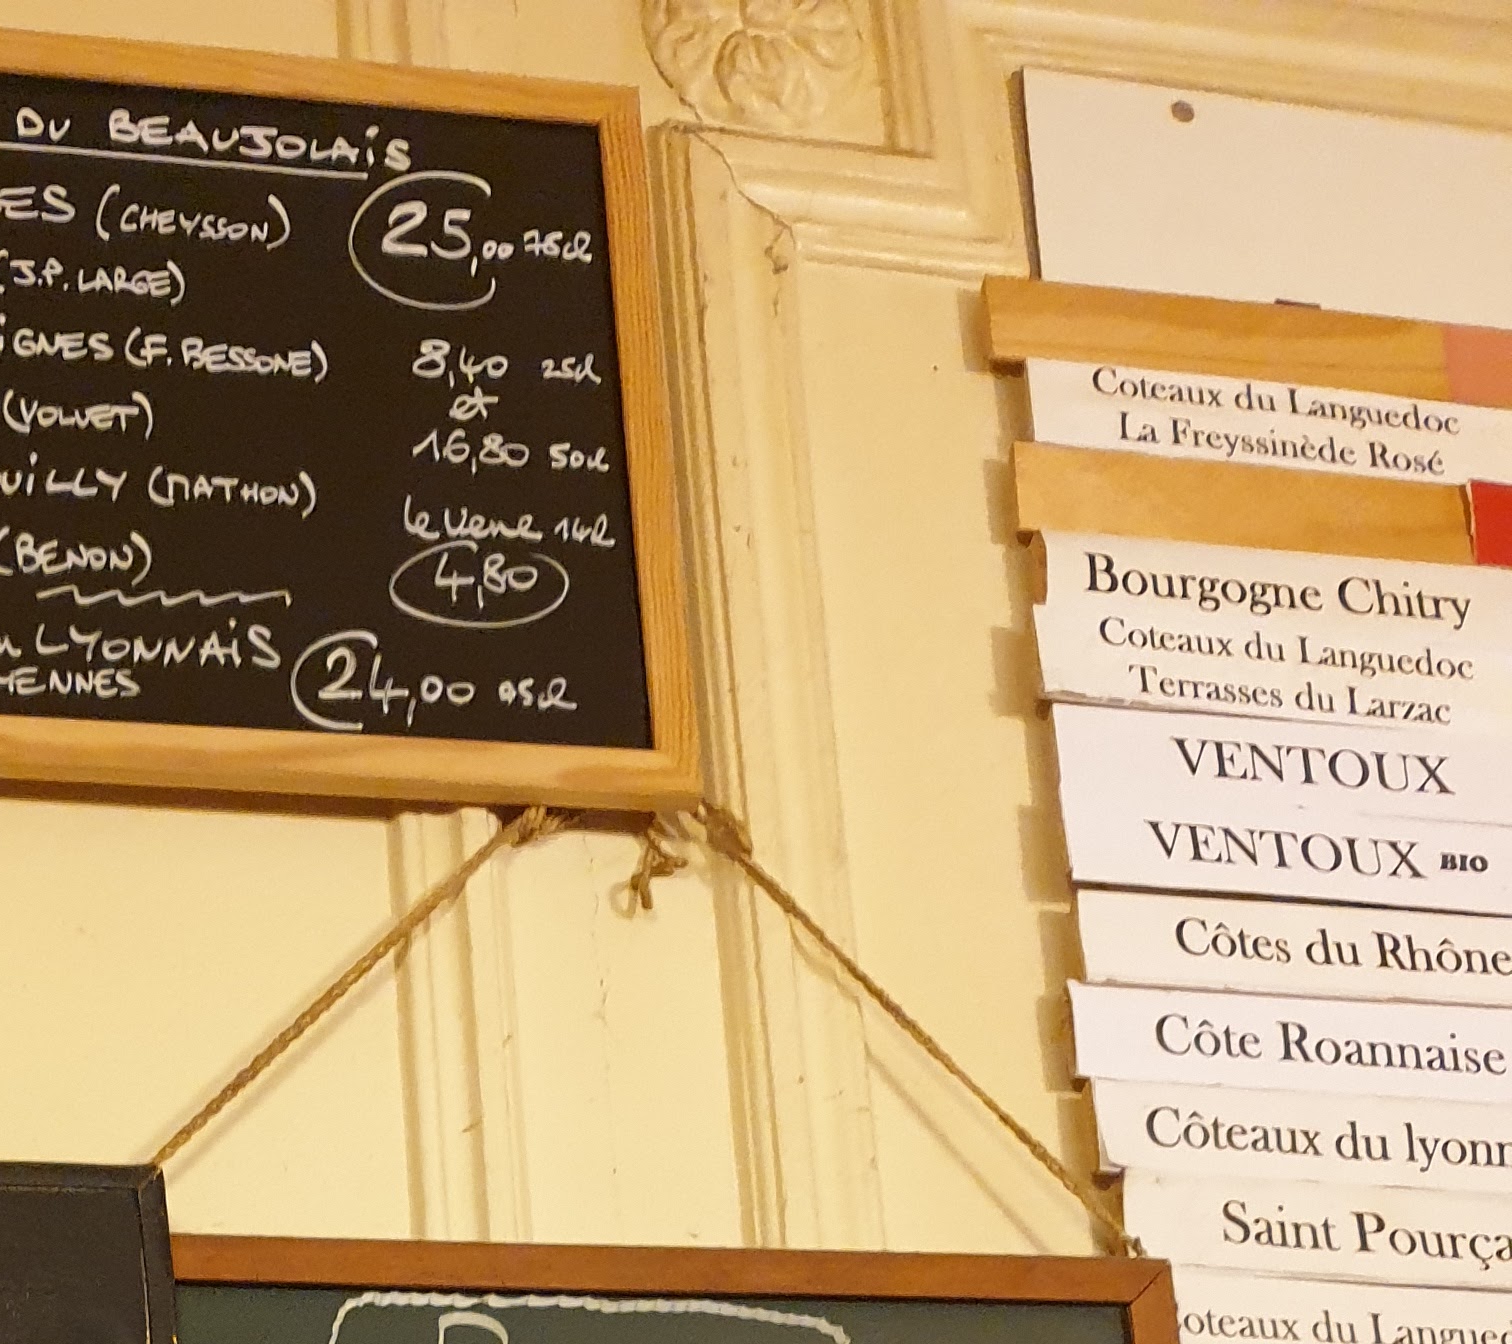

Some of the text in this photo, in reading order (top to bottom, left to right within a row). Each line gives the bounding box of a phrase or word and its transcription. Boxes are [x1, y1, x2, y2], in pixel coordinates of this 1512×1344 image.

[1092, 367, 1460, 436] Coteaux du Languedoc
[1119, 413, 1445, 476] La Freyssinède Rosé
[1085, 552, 1470, 629] Bourgogne Chitry
[1099, 616, 1474, 680] Coteaux du Languedoc
[1128, 664, 1452, 725] Terrasses du Larzac
[1171, 737, 1455, 795] VENTOUX
[1144, 820, 1488, 879] VENTOUX BIO
[1176, 917, 1360, 968] Côtes du
[1154, 1014, 1506, 1075] Côte Roannaise
[1145, 1106, 1389, 1161] Côteaux du
[1223, 1200, 1339, 1251] Saint
[1312, 1309, 1358, 1344] du
